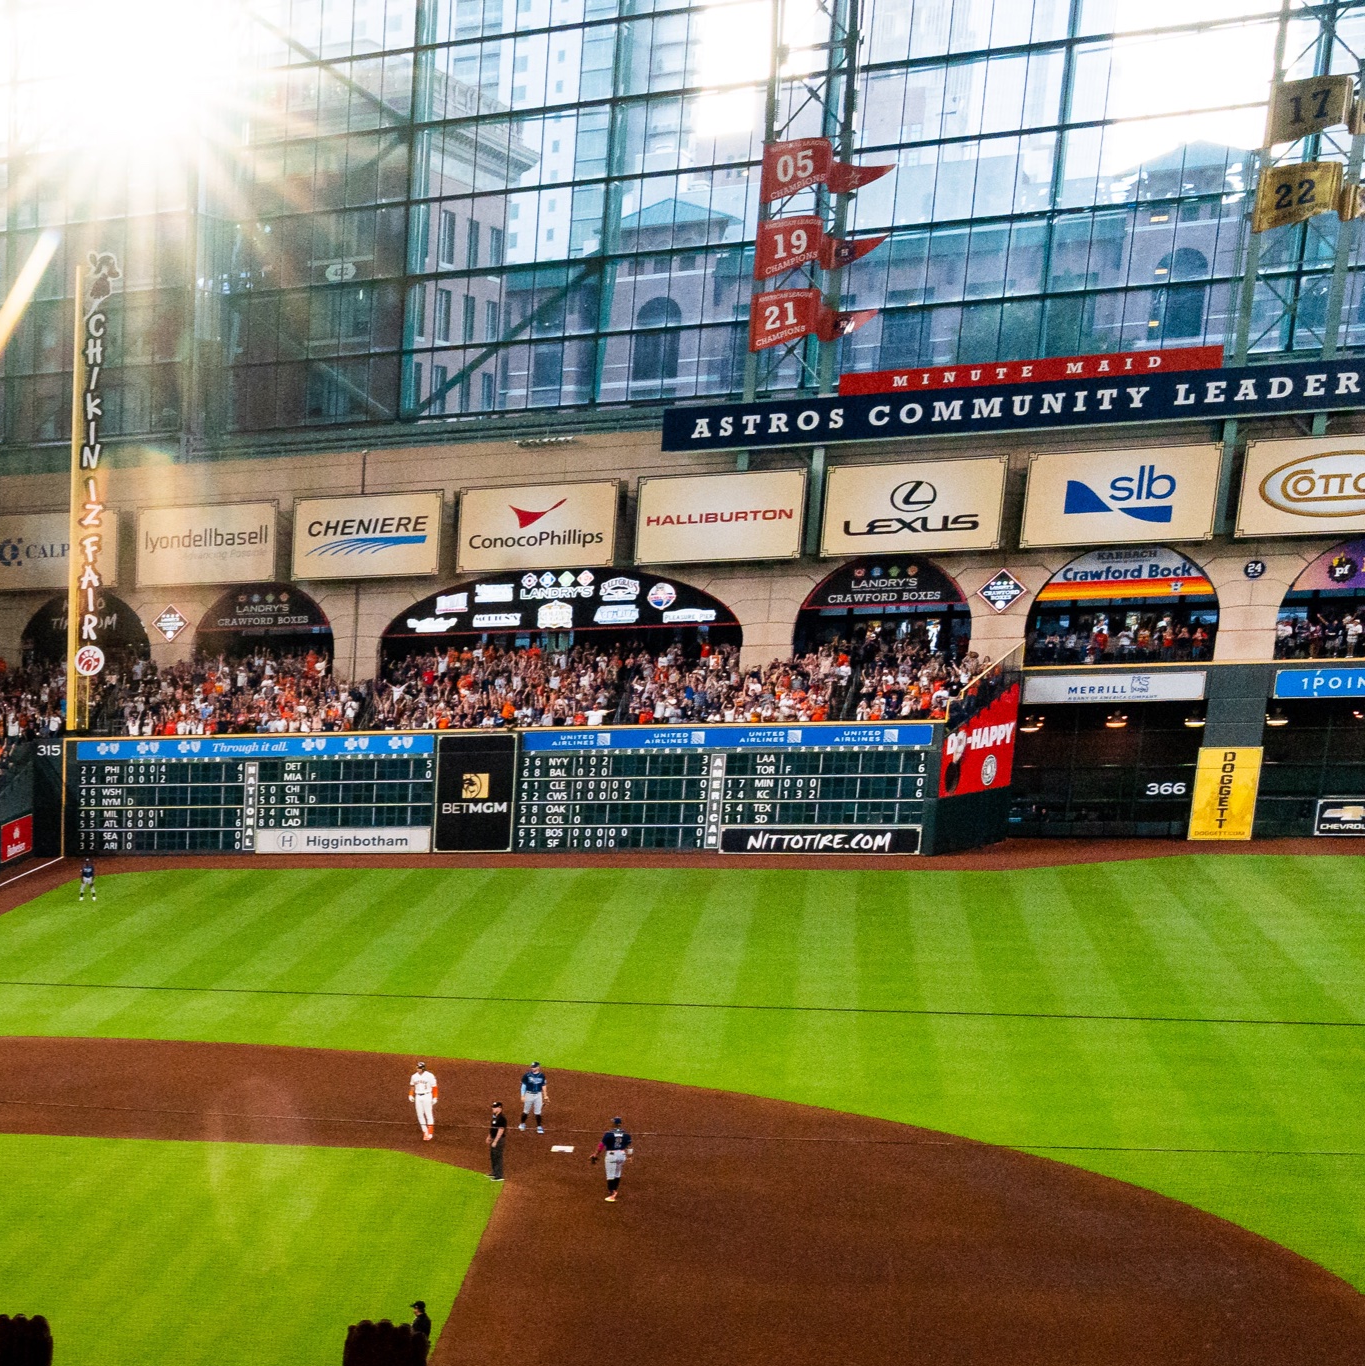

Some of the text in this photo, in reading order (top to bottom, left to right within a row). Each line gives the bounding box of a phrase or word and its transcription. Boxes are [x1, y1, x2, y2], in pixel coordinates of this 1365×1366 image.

[776, 149, 814, 183] 05
[770, 173, 827, 200] CHAMPIONS
[1275, 179, 1316, 210] 22
[774, 229, 808, 259] 19
[765, 251, 818, 275] CHAMPIONS
[764, 301, 797, 331] 21
[756, 325, 806, 347] CHAMPIONS
[893, 355, 1162, 388] MINUTE MAID
[690, 408, 843, 440] ASTROS
[868, 385, 1150, 426] COMMUNITY
[1109, 465, 1176, 502] slb
[646, 508, 794, 526] HALLIBURTON
[307, 515, 429, 537] CHENIERE
[844, 513, 979, 536] LEXUS
[145, 525, 268, 554] lyondellbasell
[469, 529, 604, 551] ConocoPhillips
[1097, 551, 1158, 561] KARBACH
[1063, 562, 1193, 582] Crawford Bock
[1247, 563, 1262, 573] 24
[852, 577, 918, 589] LANDRY'S
[521, 586, 593, 599] LANDRY'S
[828, 591, 942, 604] CRAWFORD BOXES
[236, 604, 290, 615] LANDRY'S
[218, 615, 309, 627] CRAWFORD BOXES
[664, 612, 714, 621] PLEASURE PIER
[1068, 686, 1127, 695] MERRILL
[36, 744, 61, 757] 315
[212, 740, 289, 755] Through it all.
[548, 757, 569, 767] NYY
[756, 754, 776, 763] LAA
[105, 765, 120, 774] PHI
[285, 762, 302, 772] DET
[755, 765, 775, 775] TOR
[283, 772, 303, 782] MIA
[549, 768, 567, 777] BAL
[105, 775, 119, 784] PIT
[754, 779, 774, 788] MIN
[285, 785, 300, 794] CHI
[549, 781, 566, 790] CLE
[1145, 782, 1186, 795] 366
[1215, 751, 1237, 829] DOGGETT
[102, 788, 122, 796] WSH
[546, 792, 568, 801] CWS
[756, 790, 770, 799] KC
[101, 797, 121, 807] NYM
[285, 795, 300, 804] STL
[244, 765, 256, 847] NATIONAL
[442, 801, 508, 815] BETMGM
[545, 805, 567, 814] OAK
[753, 804, 772, 813] TEX
[103, 810, 119, 818] MIL
[284, 808, 299, 817] CIN
[103, 819, 119, 828] ATL
[281, 818, 301, 827] LAD
[545, 816, 565, 825] COL
[754, 815, 768, 824] SD
[102, 832, 119, 841] SEA
[545, 828, 564, 837] BOS
[103, 842, 118, 850] ARI
[306, 835, 409, 850] Higginbotham
[546, 839, 559, 848] SF
[747, 830, 892, 852] NITTOTIRE.COM
